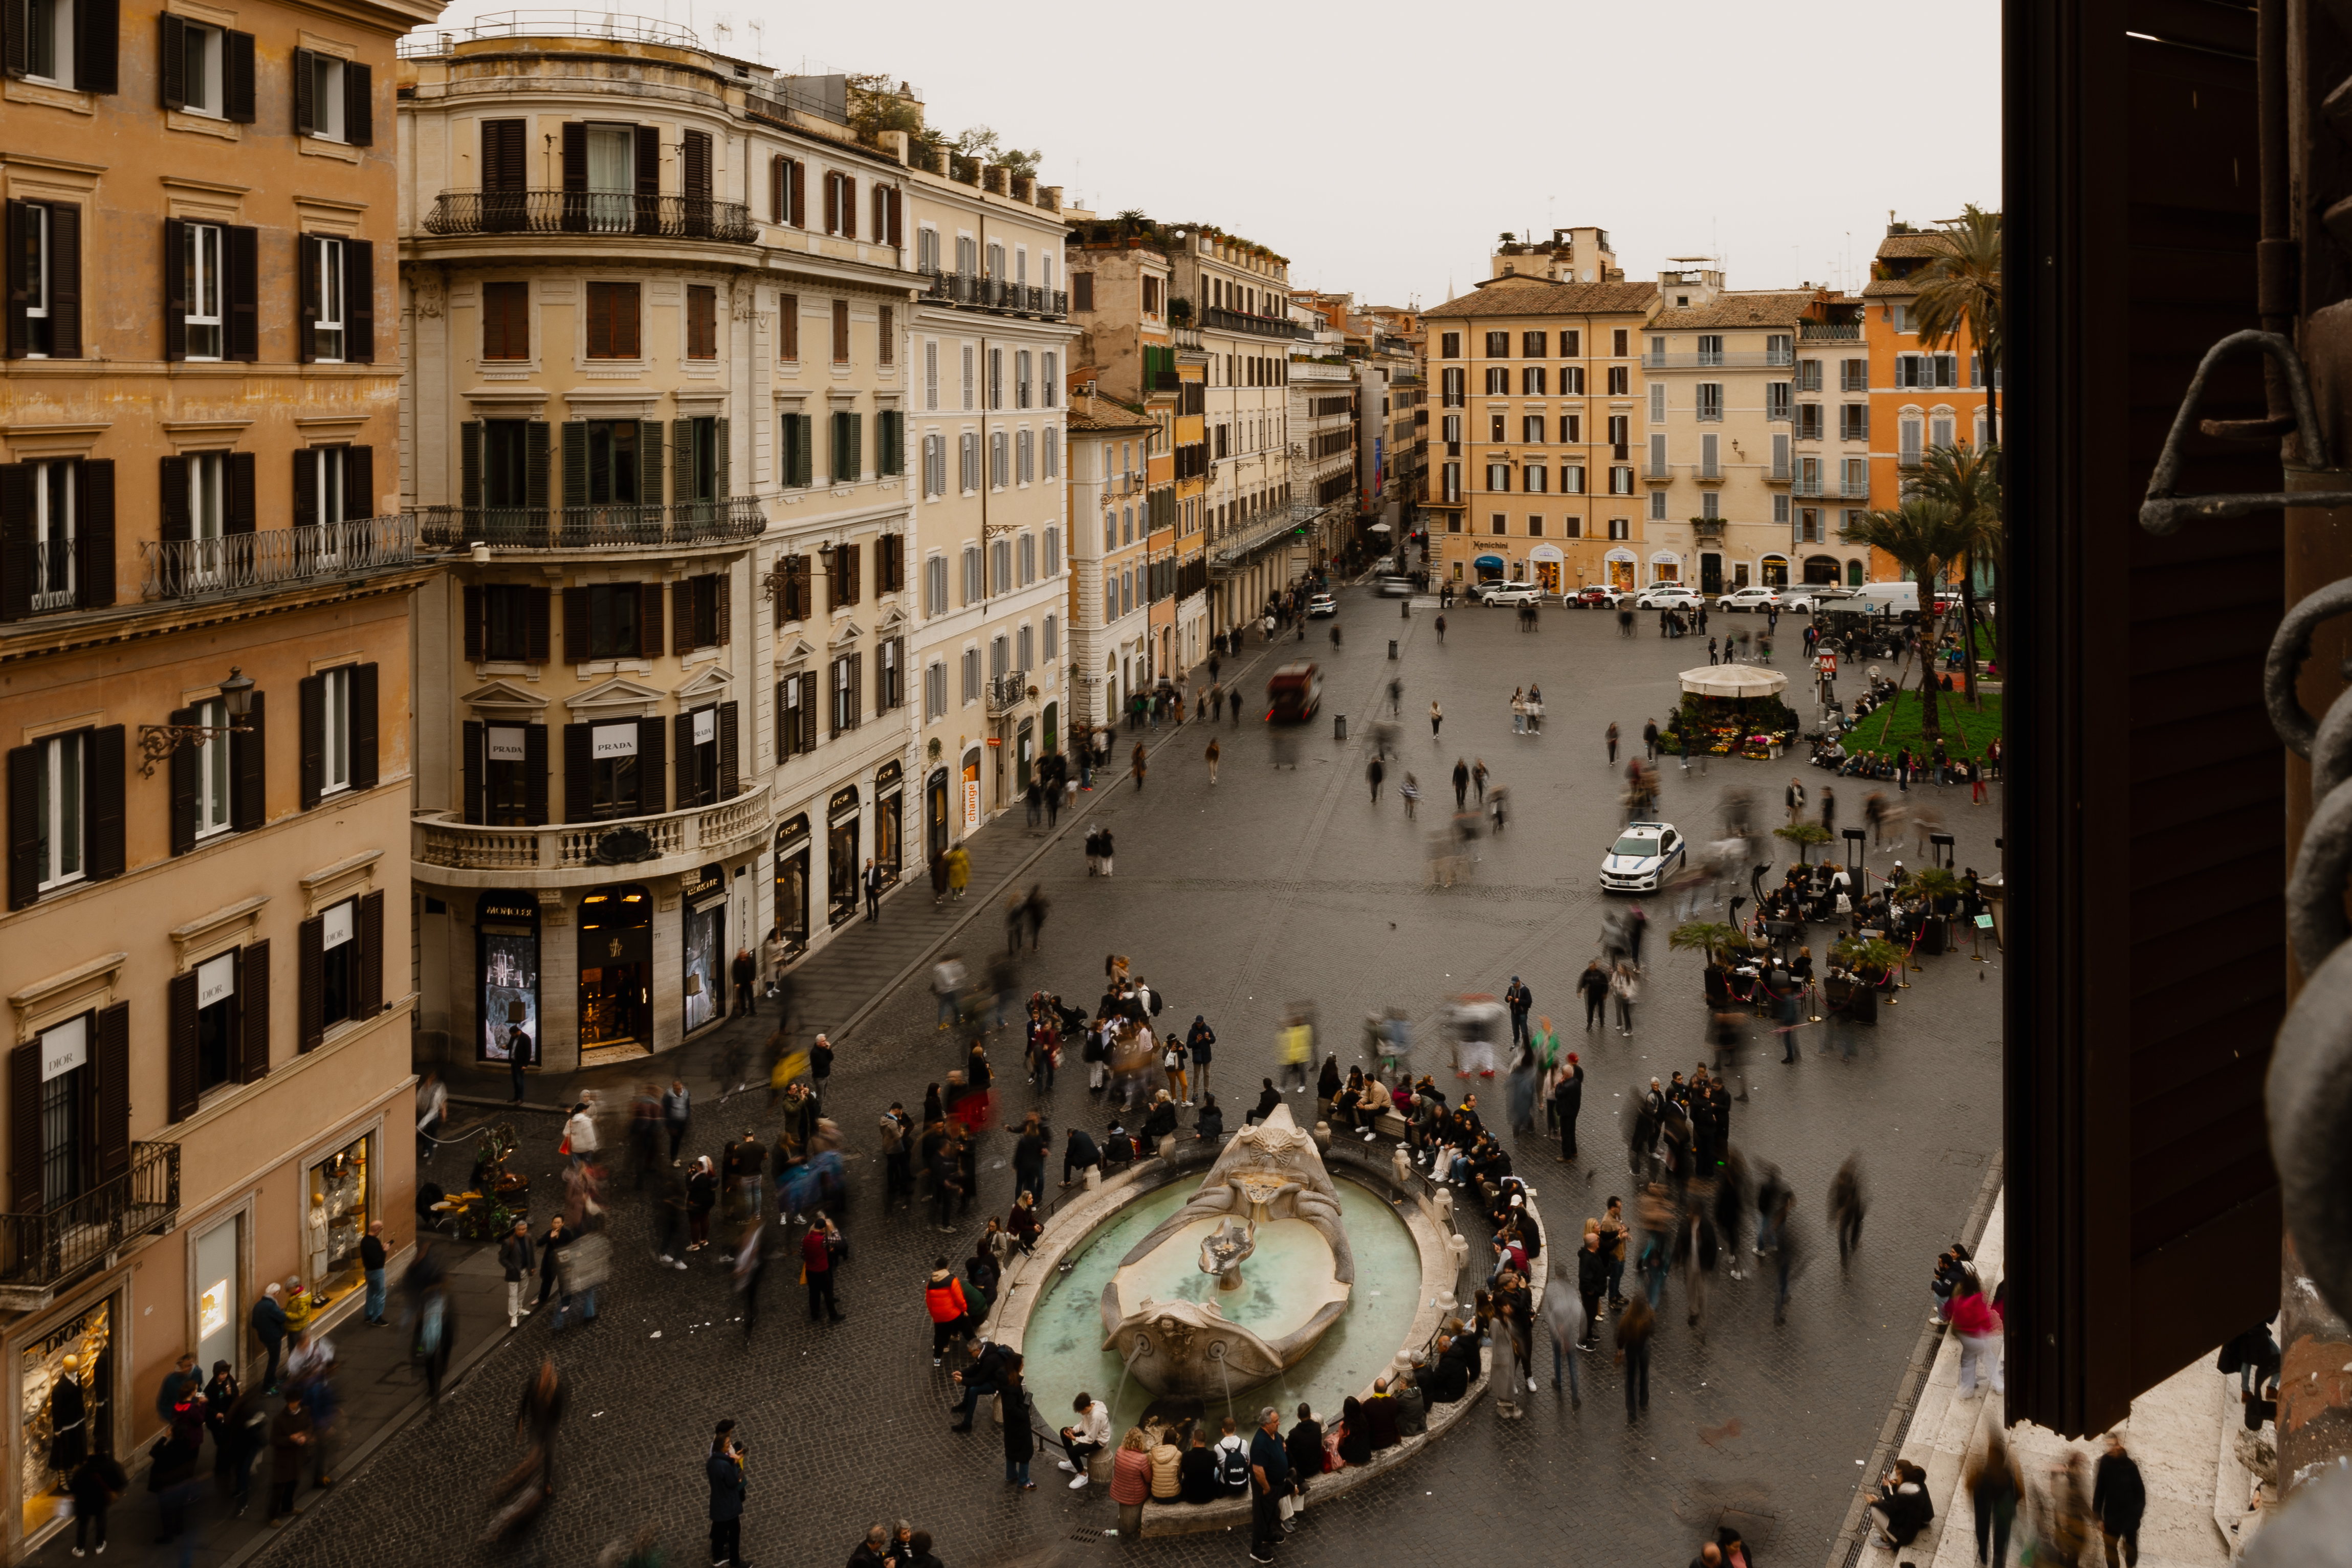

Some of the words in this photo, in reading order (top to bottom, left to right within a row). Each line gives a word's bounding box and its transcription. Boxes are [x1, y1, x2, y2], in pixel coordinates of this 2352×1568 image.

[1473, 541, 1508, 550] Menichini
[598, 742, 632, 751] PRADA
[968, 784, 977, 822] change
[487, 906, 532, 916] MONCLER
[326, 929, 343, 943] DIOR
[203, 984, 222, 1001] DIOR
[49, 1052, 73, 1072] DIOR
[385, 1108, 391, 1118] 75
[46, 1317, 87, 1356] DIOR
